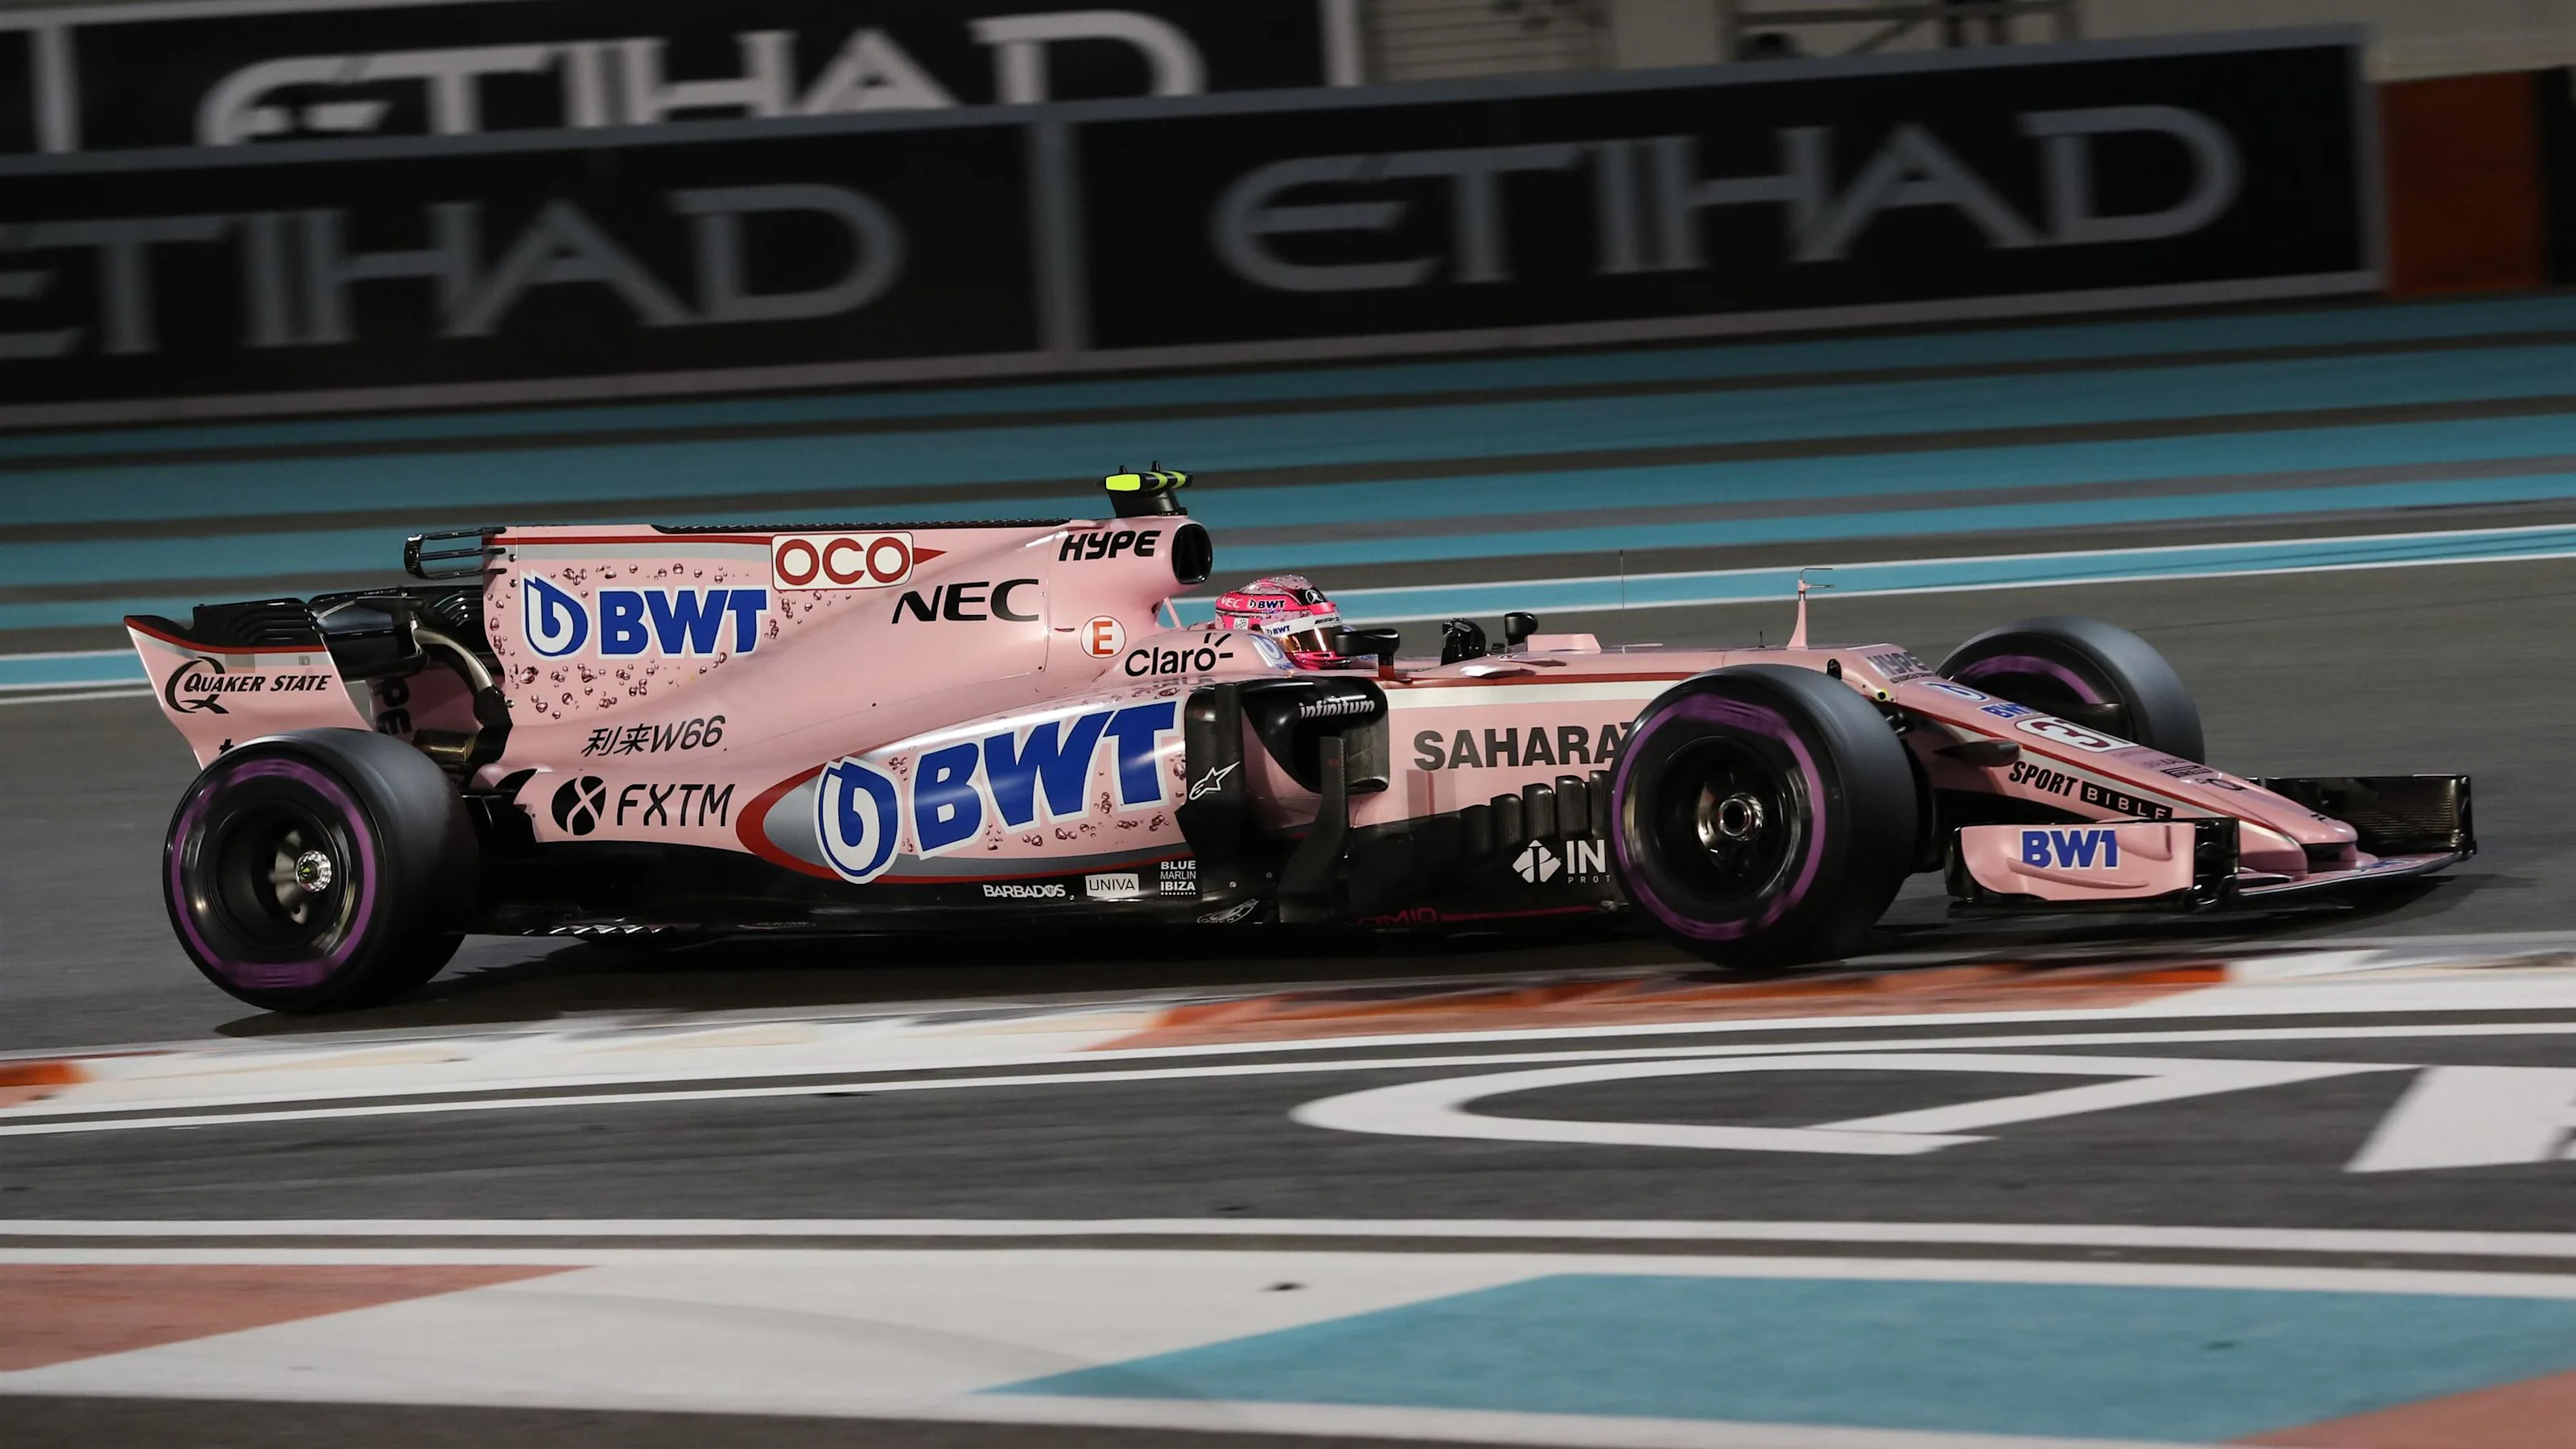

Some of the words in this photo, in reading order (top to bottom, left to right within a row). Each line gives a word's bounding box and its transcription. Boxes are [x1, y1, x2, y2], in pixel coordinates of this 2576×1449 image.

[1213, 105, 2244, 293] ETIHAD
[775, 537, 911, 584] OCO
[1059, 530, 1161, 561] HYPE
[891, 578, 1039, 624] NEC
[1257, 599, 1286, 609] BWT
[599, 588, 767, 656] BWT
[1092, 621, 1113, 654] E
[1273, 625, 1291, 635] BWT
[1125, 646, 1216, 677] Claro
[184, 673, 266, 692] QUAKER
[270, 675, 332, 691] STATE
[1298, 700, 1376, 719] infinitum
[580, 715, 726, 758] 利来W66
[913, 700, 1177, 852] BWT
[2008, 761, 2079, 797] SPORT
[2087, 786, 2167, 819] BIBLE
[616, 783, 736, 827] FXTM
[1160, 860, 1196, 870] BLUE
[1160, 870, 1196, 880] MARLIN
[982, 884, 1066, 898] BARBADOS
[1088, 878, 1135, 891] UNIVA
[1160, 881, 1196, 891] IBIZA
